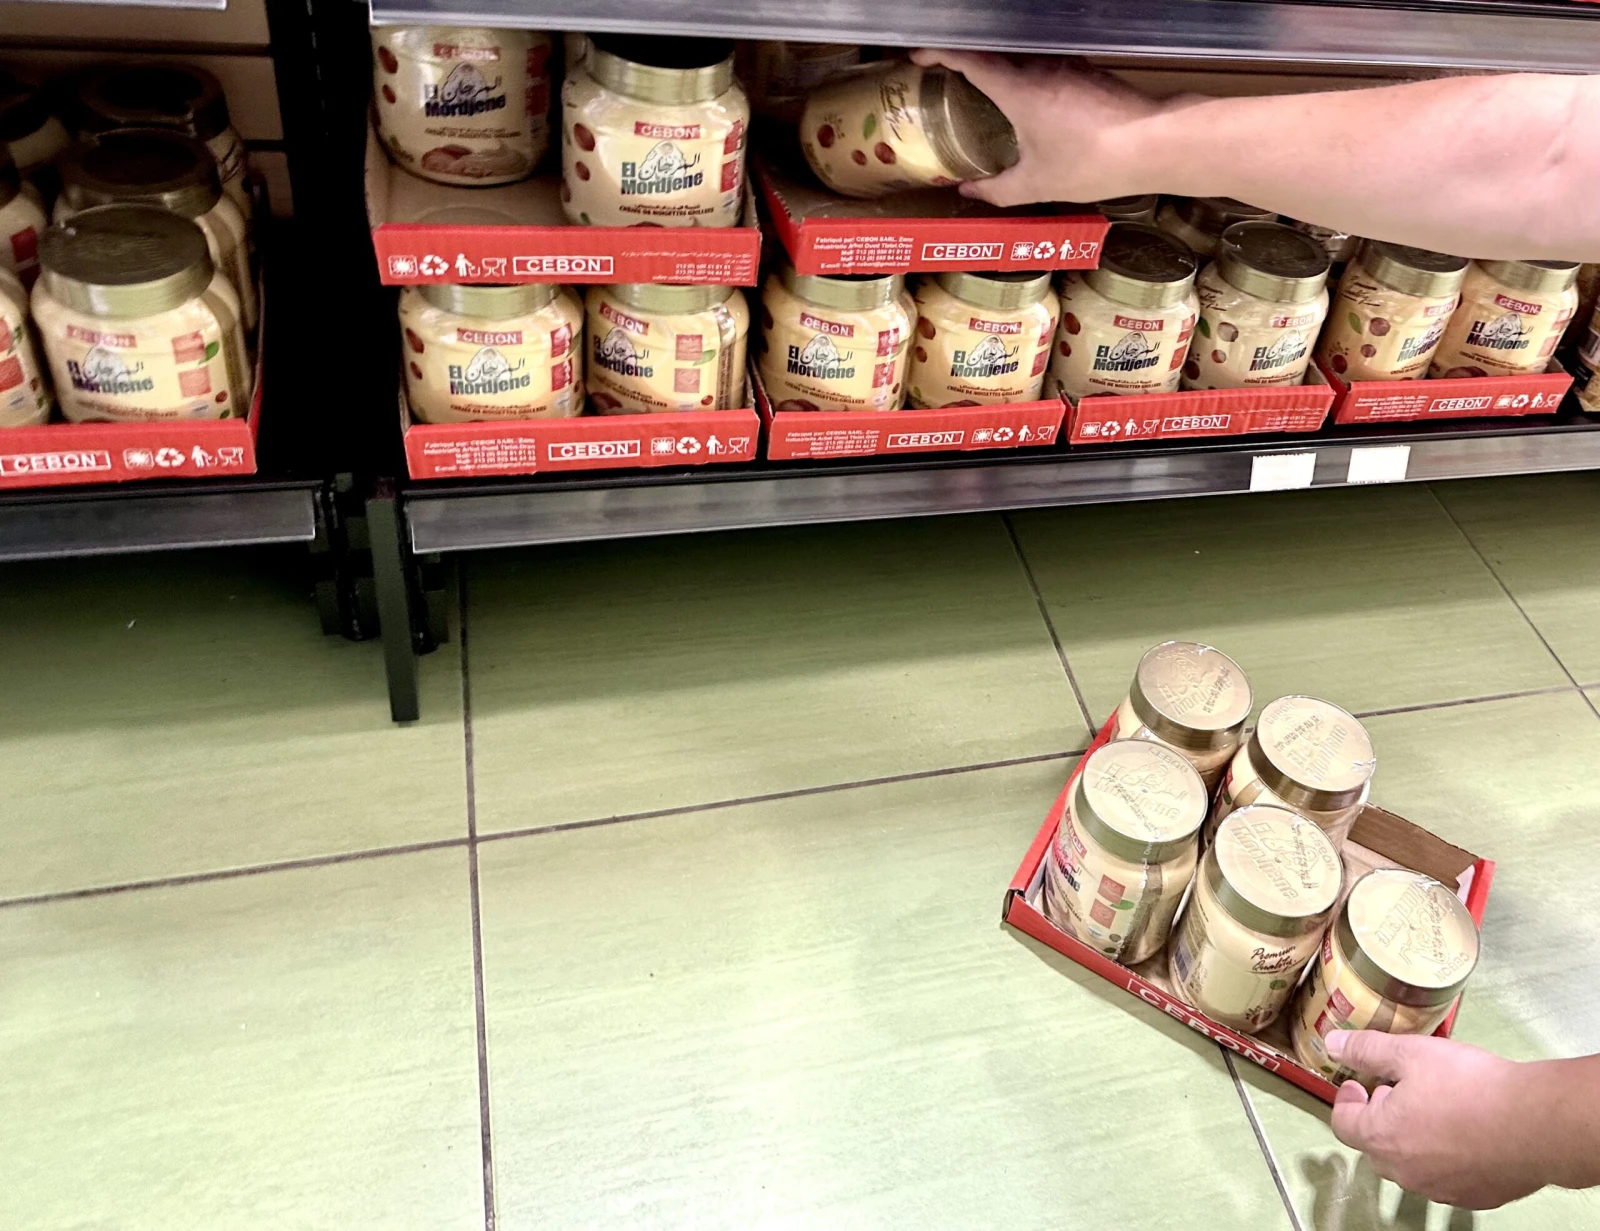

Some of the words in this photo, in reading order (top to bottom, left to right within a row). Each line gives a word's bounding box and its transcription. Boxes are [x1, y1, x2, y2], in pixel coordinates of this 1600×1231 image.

[641, 125, 696, 138] CEBON
[621, 162, 636, 178] El
[621, 170, 704, 195] Mordjene
[933, 246, 993, 258] CEBON
[527, 259, 601, 271] CEBON
[1499, 298, 1538, 314] CEBON
[603, 306, 644, 333] CEBON
[804, 317, 849, 336] CEBON
[974, 321, 1018, 332] CEBON
[1119, 319, 1160, 330] CEBON
[1471, 320, 1485, 333] El
[463, 331, 517, 344] CEBON
[1466, 333, 1530, 350] Mordjene
[788, 345, 799, 360] El
[954, 350, 966, 363] El
[1096, 345, 1109, 357] El
[1254, 346, 1267, 359] El
[787, 360, 855, 379] Mordjene
[951, 360, 1019, 378] Mordjene
[1093, 356, 1159, 372] Mordjene
[449, 365, 462, 379] El
[450, 372, 531, 395] Mordjene
[1438, 400, 1483, 410] CEBON
[1172, 417, 1222, 429] CEBON
[898, 434, 953, 445] CEBON
[561, 444, 629, 459] CEBON
[13, 453, 97, 473] CEBON
[1139, 988, 1268, 1066] CEBON
